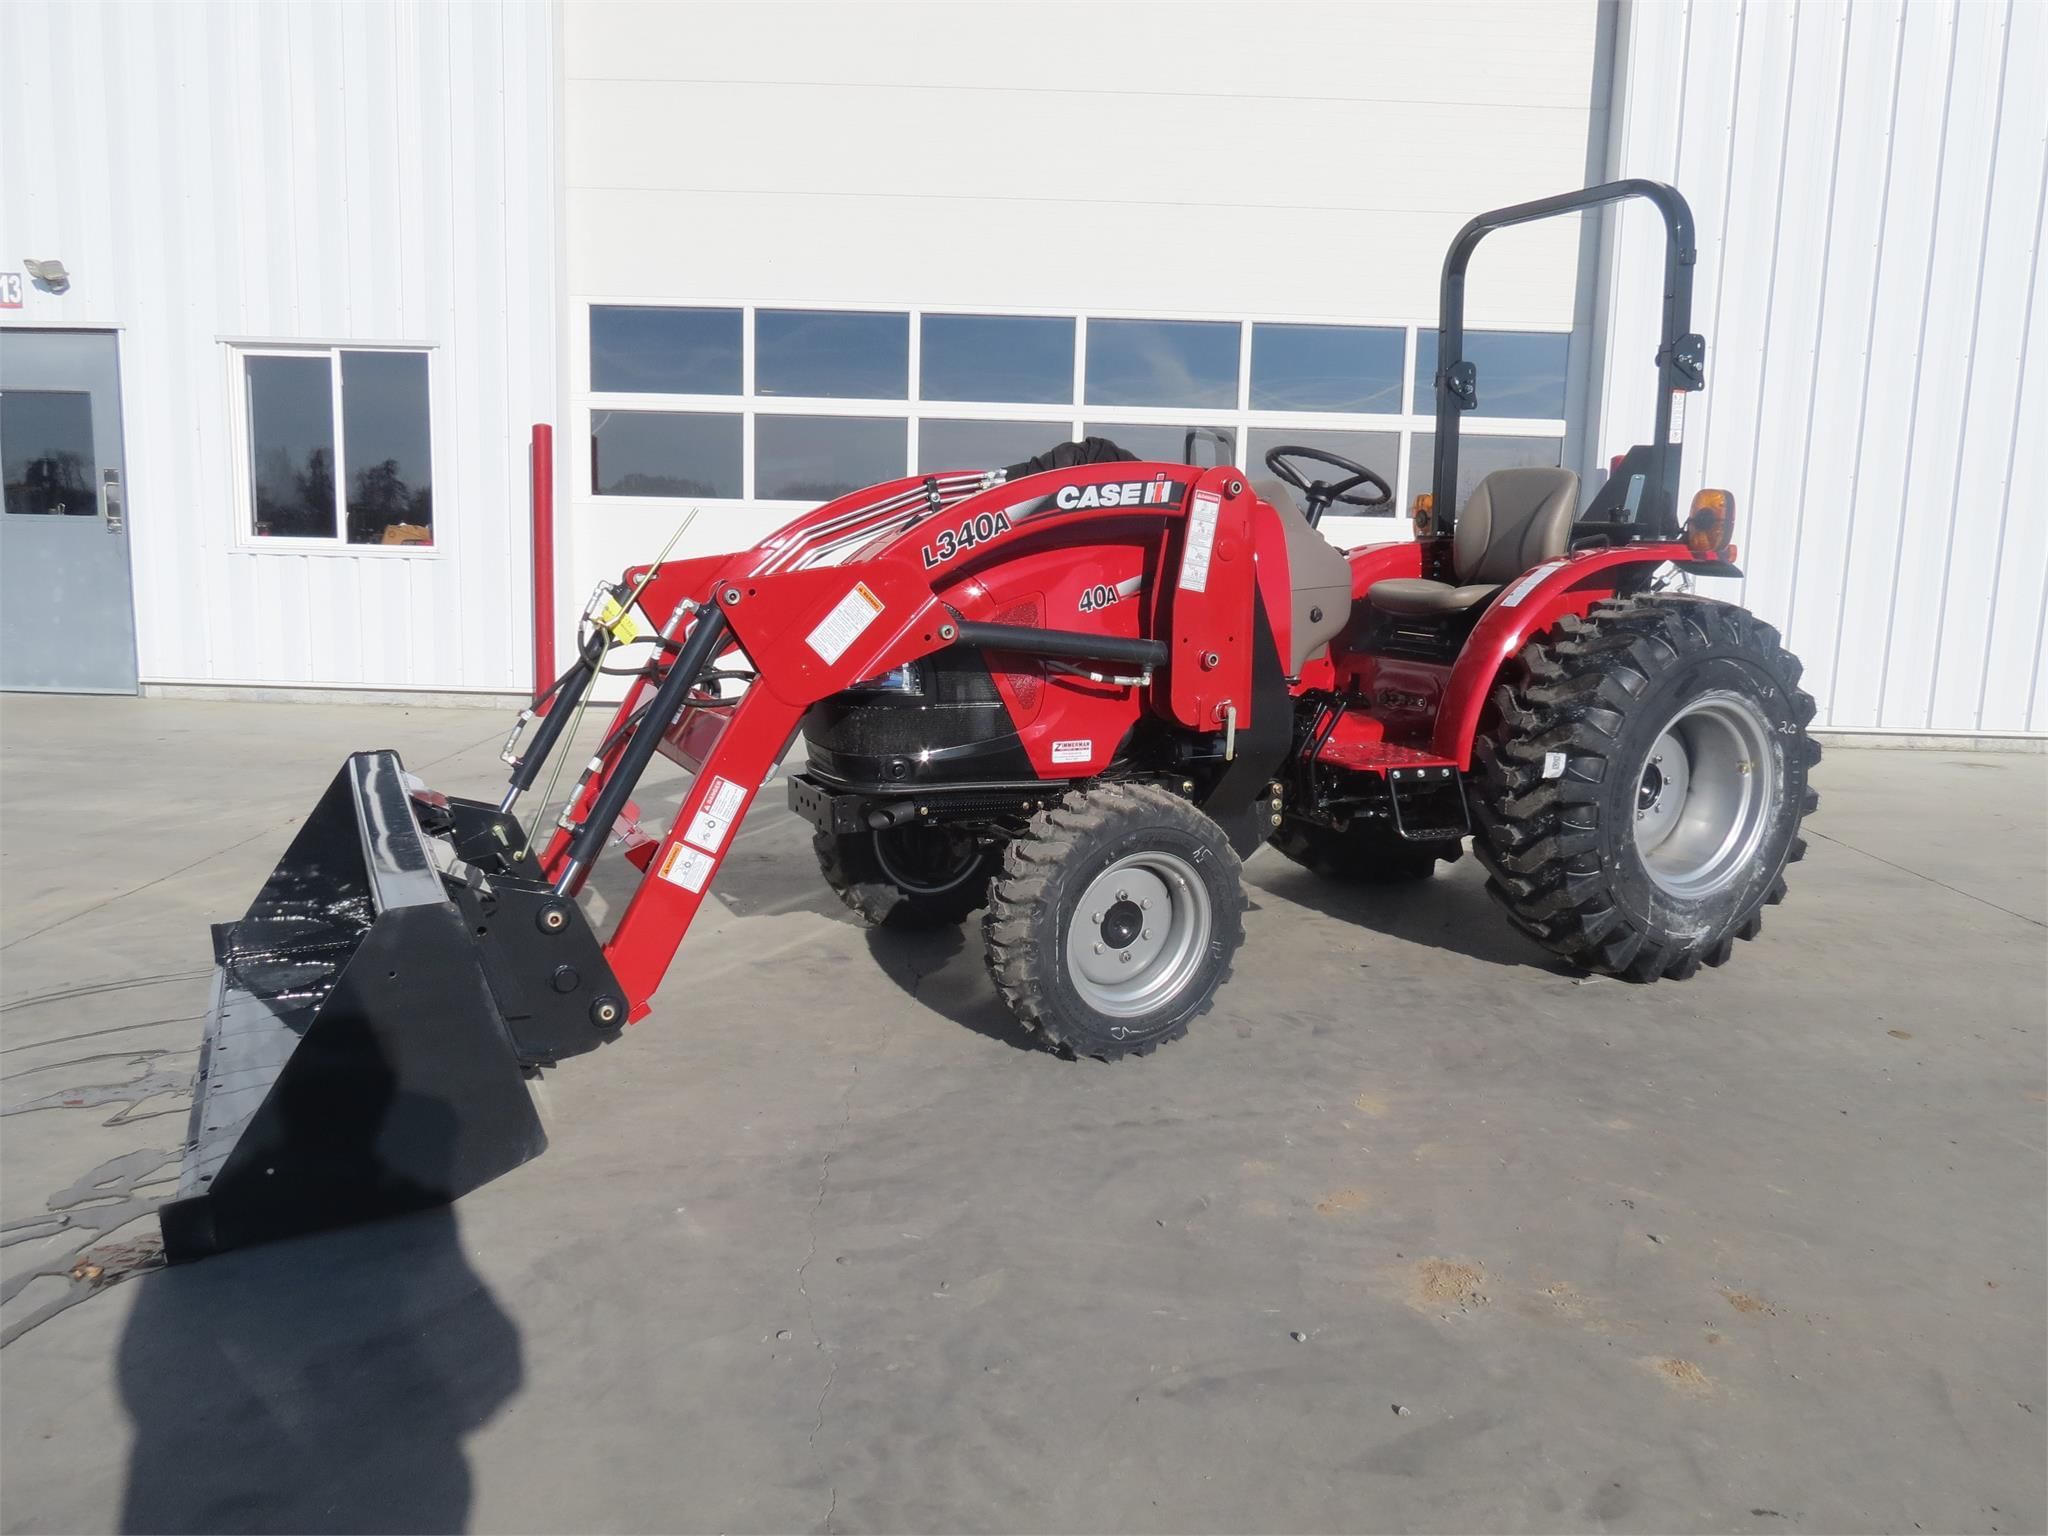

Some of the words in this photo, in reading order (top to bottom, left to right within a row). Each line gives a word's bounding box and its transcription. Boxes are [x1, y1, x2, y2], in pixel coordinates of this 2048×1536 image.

[1056, 483, 1141, 511] CASE
[922, 511, 1011, 568] L340A
[1078, 585, 1119, 613] 40A
